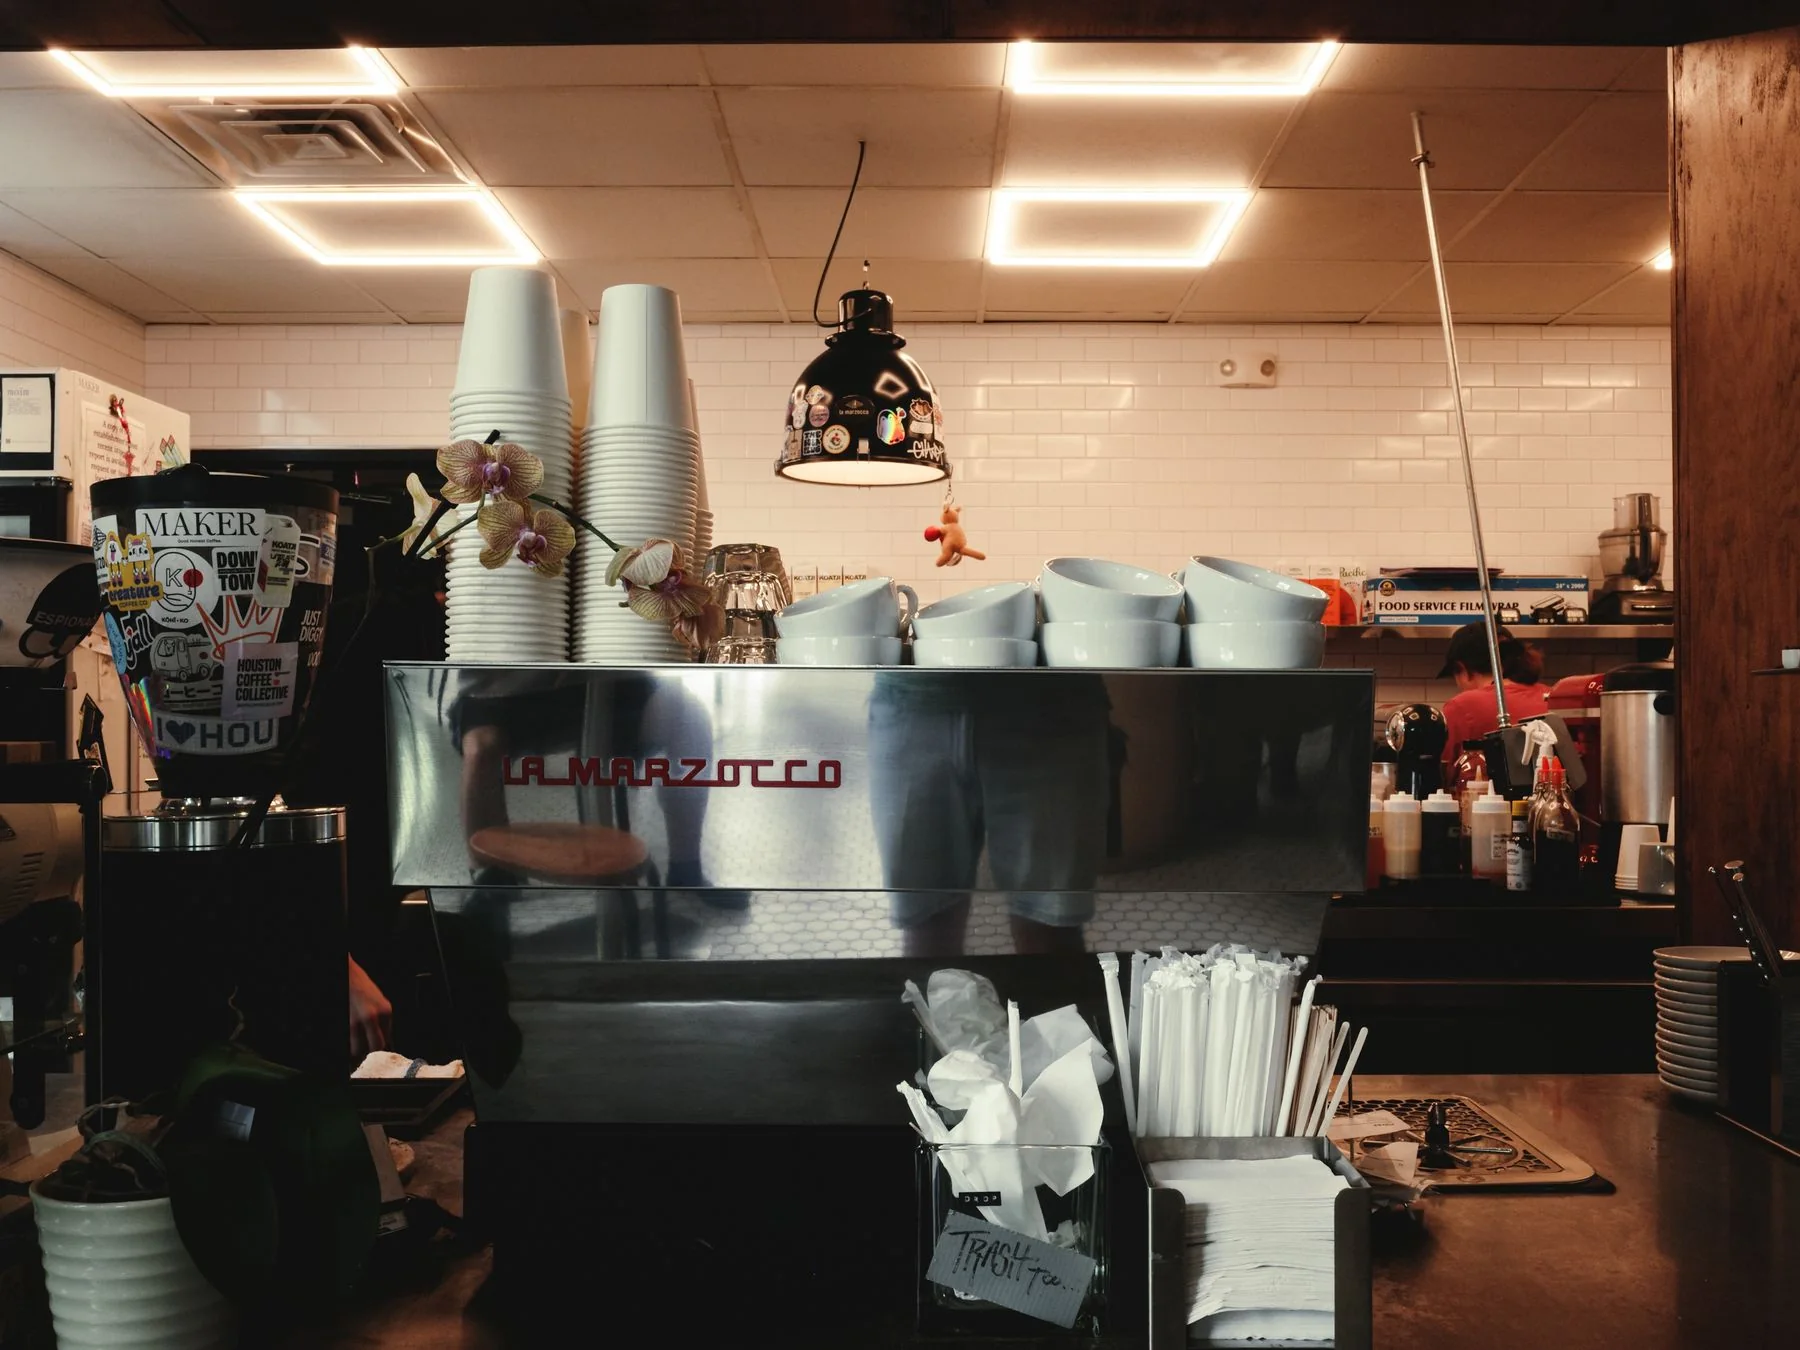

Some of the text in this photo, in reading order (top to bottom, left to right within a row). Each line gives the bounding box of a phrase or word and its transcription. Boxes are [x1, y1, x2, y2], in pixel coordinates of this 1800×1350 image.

[142, 511, 260, 537] MAKER
[1339, 567, 1366, 578] Pacific
[217, 573, 255, 591] TOW
[109, 585, 160, 601] creature
[1379, 601, 1410, 611] FOOD
[1413, 601, 1457, 611] SERVICE
[1460, 602, 1484, 611] FILM
[300, 609, 322, 626] JUST
[237, 658, 282, 672] HOUSTON
[236, 673, 272, 686] COFFEE
[235, 686, 288, 702] COLLECTIVE
[156, 717, 273, 748] I HOU
[503, 756, 545, 786] LA
[948, 1230, 1034, 1282] TRASH
